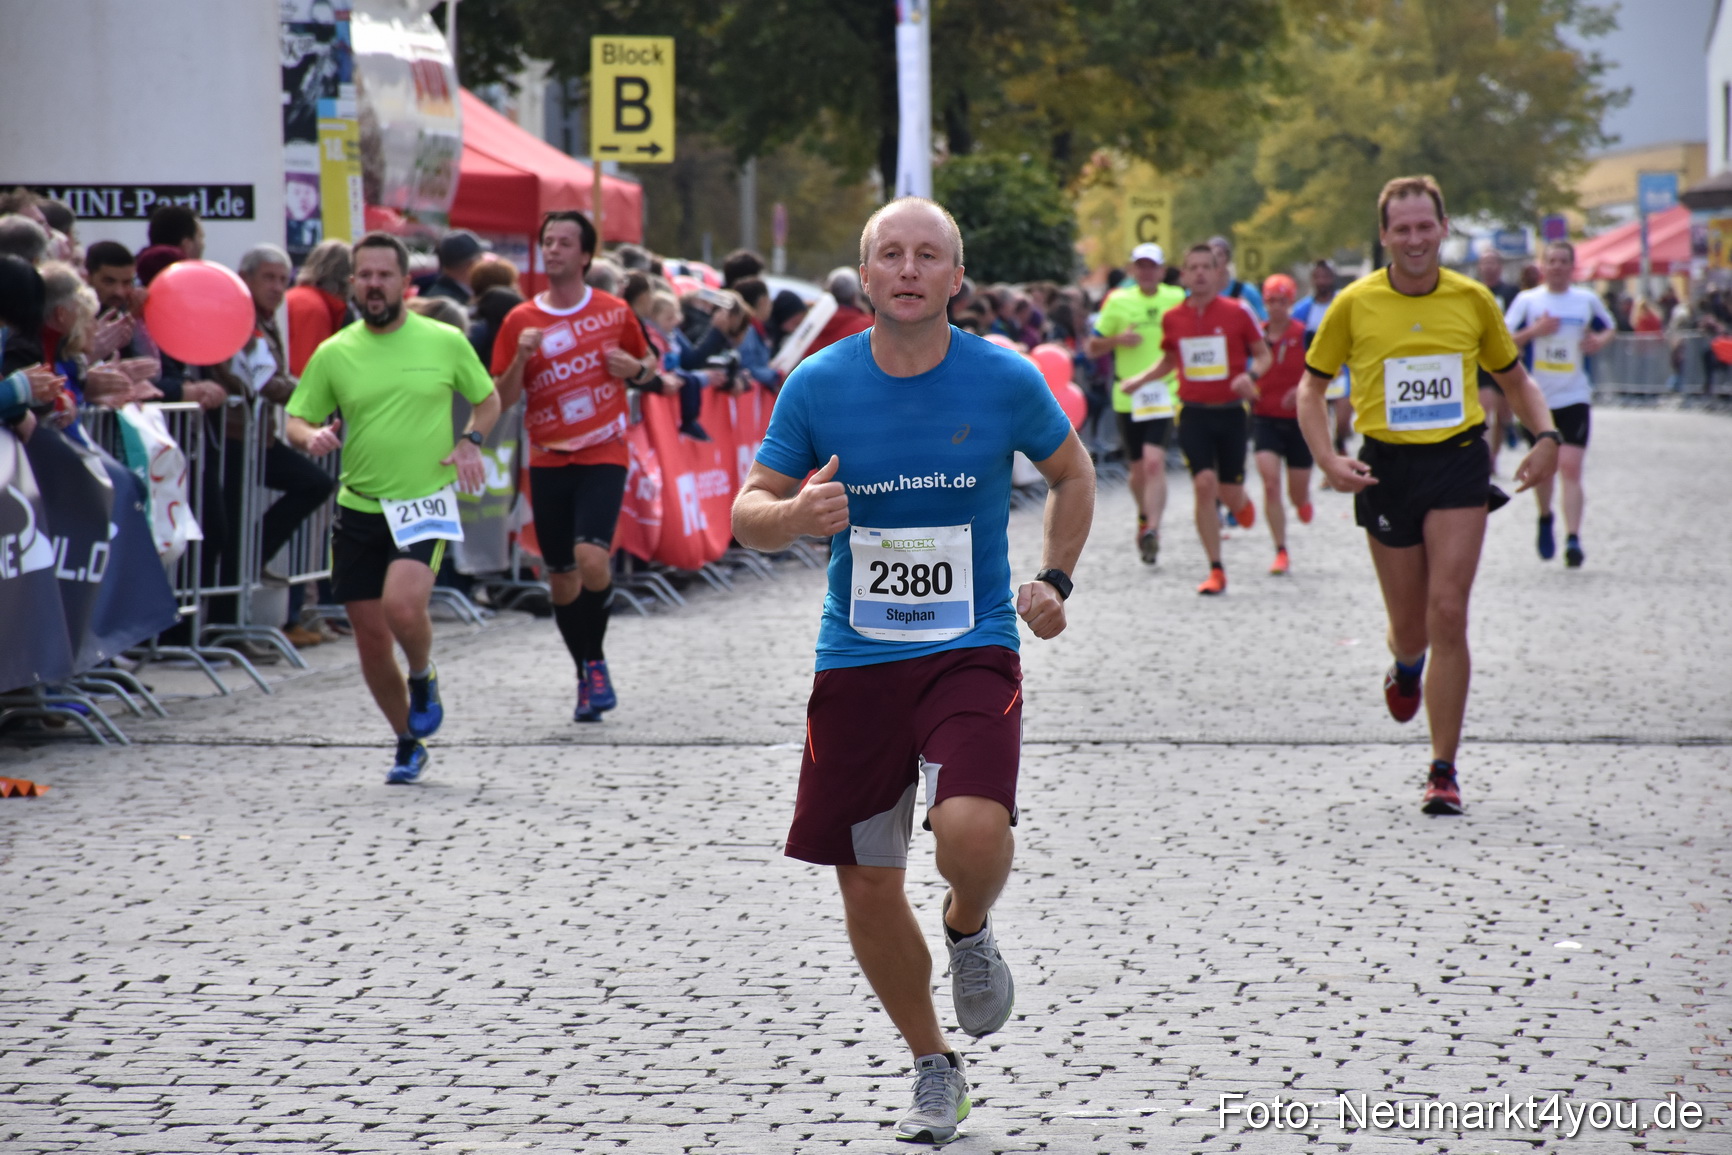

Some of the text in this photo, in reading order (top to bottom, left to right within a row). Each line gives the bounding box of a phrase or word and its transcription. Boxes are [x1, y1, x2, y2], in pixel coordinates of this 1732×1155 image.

[601, 43, 664, 66] Block
[614, 76, 653, 134] B
[1135, 213, 1159, 243] C
[1397, 377, 1452, 402] 2940
[847, 471, 977, 495] www.hasit.de
[396, 498, 447, 524] 2190
[893, 538, 936, 549] BOCK
[869, 560, 953, 597] 2380
[886, 608, 935, 624] Stephan
